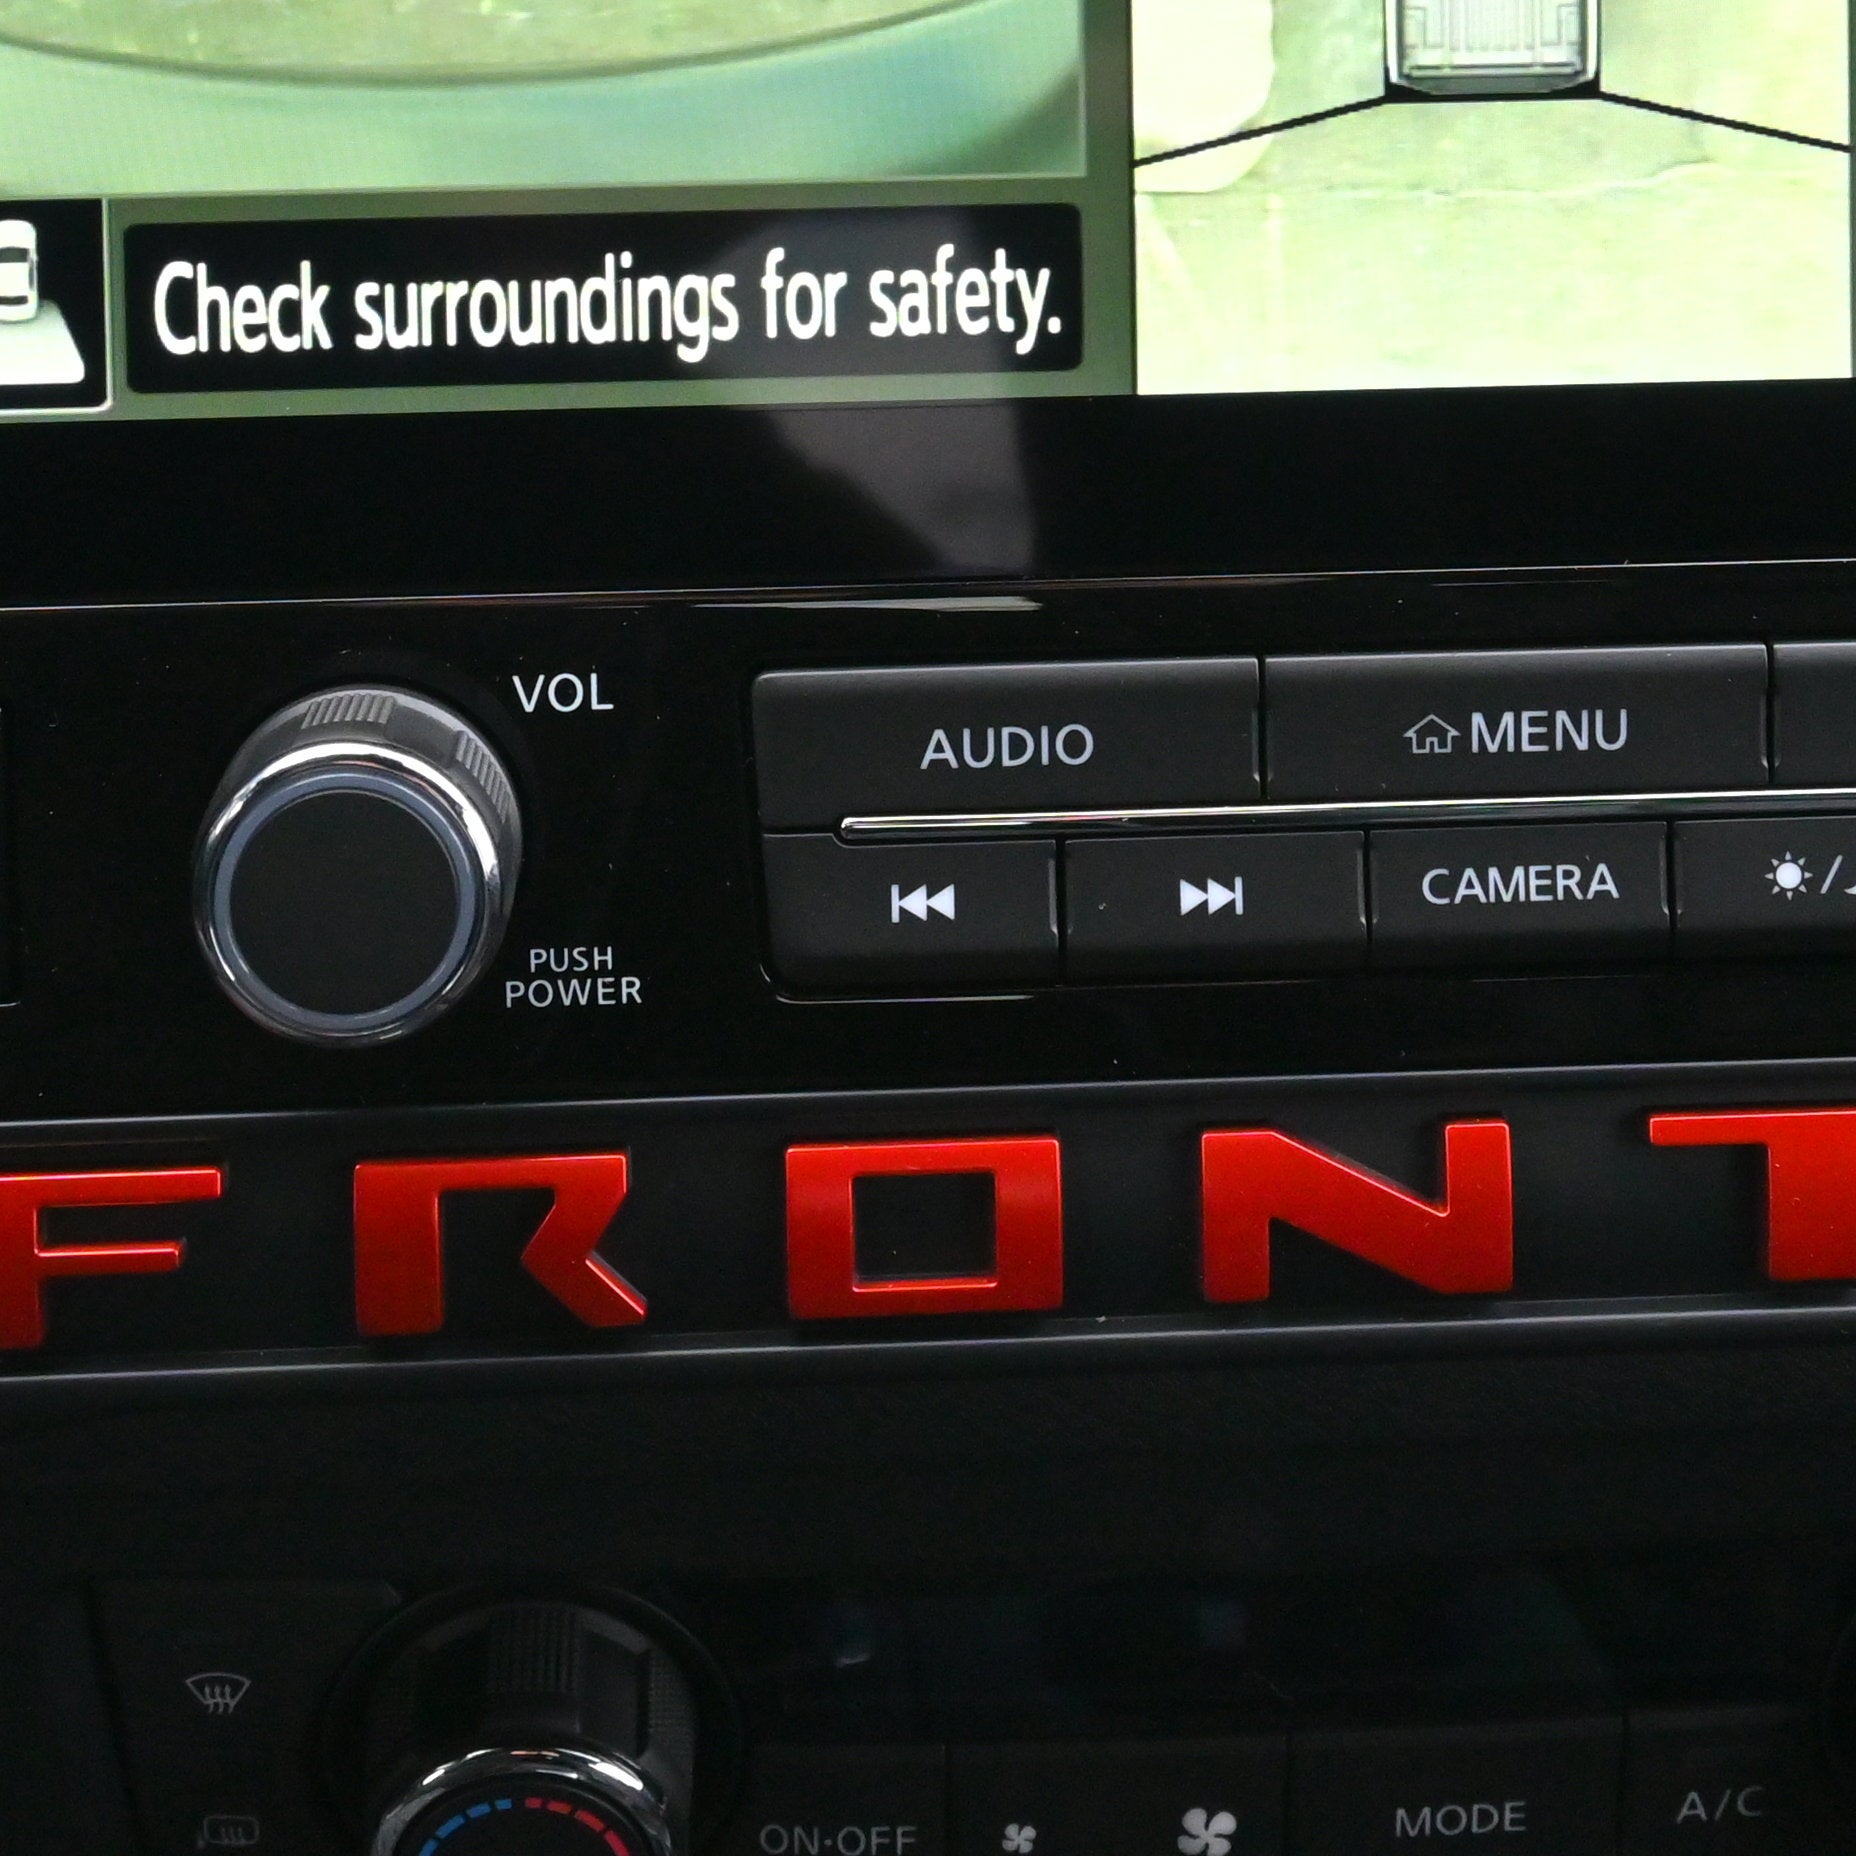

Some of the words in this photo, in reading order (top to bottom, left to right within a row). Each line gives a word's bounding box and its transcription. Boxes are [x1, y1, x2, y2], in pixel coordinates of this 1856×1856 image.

[153, 259, 333, 356] Check
[354, 250, 740, 364] surroundings
[760, 246, 848, 340] for
[868, 242, 1062, 355] safety.
[512, 672, 614, 713] VOL
[920, 723, 1094, 770] AUDIO
[1471, 708, 1628, 753] MENU
[1421, 863, 1620, 905] CAMERA
[529, 946, 613, 973] PUSH
[505, 976, 642, 1008] POWER
[1395, 1801, 1525, 1837] MODE
[1676, 1785, 1764, 1825] A/C
